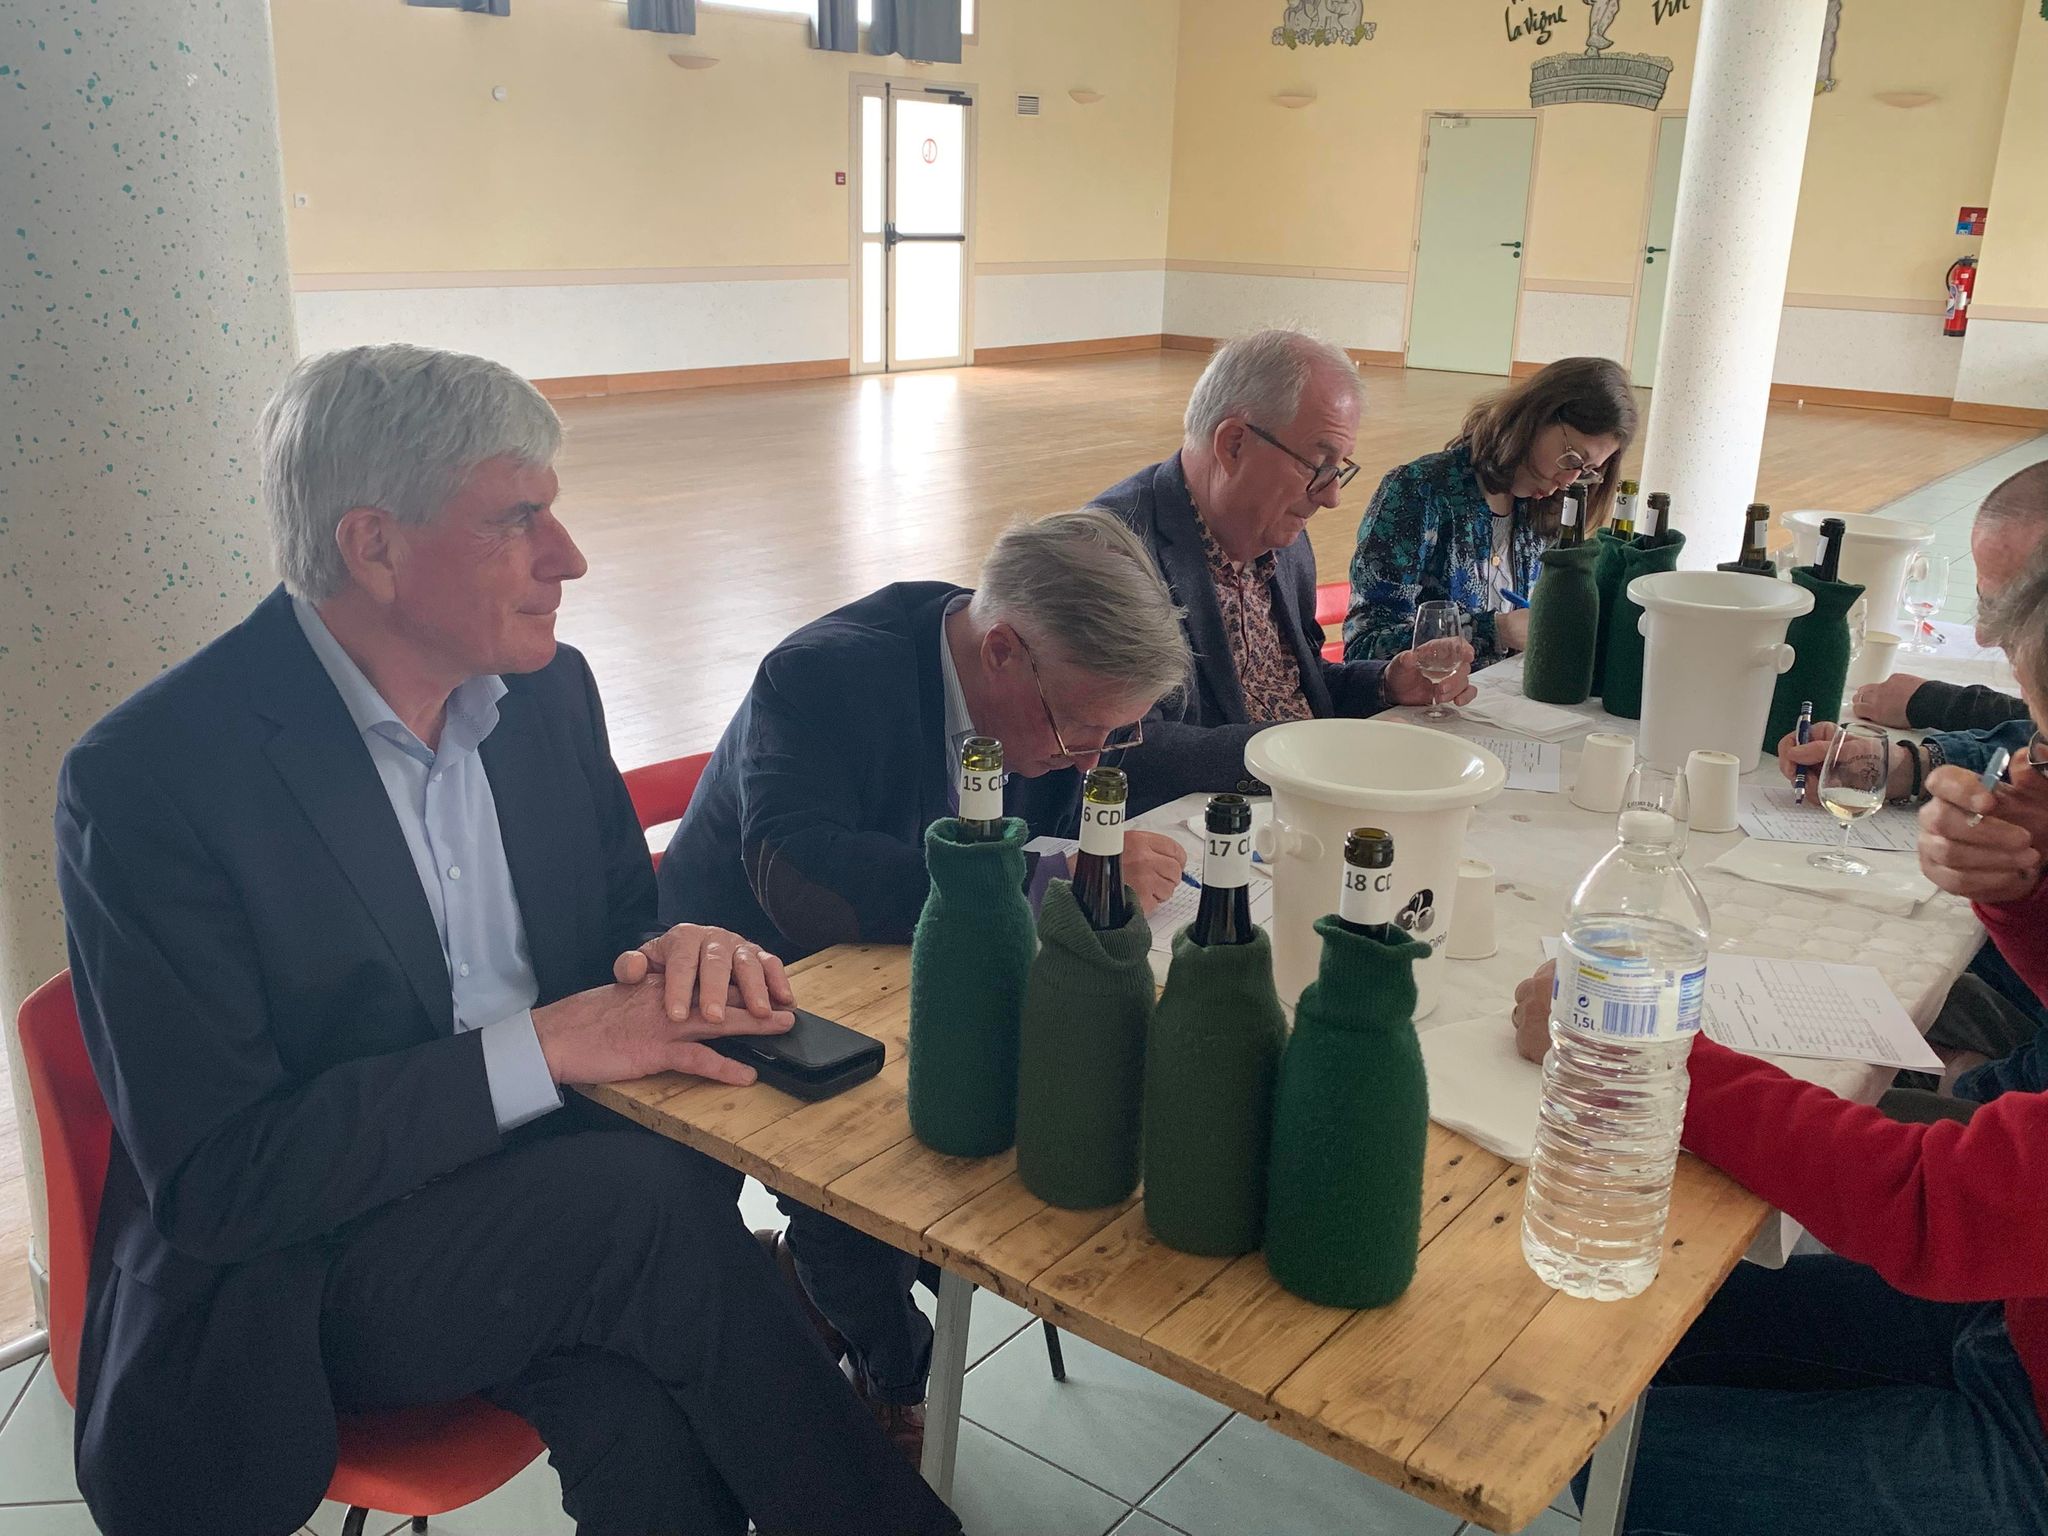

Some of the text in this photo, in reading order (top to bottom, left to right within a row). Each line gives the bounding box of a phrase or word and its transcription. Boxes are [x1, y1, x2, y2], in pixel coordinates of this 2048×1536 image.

[963, 775, 982, 792] 15
[1096, 807, 1124, 826] CD
[1209, 839, 1231, 857] 17
[1344, 870, 1367, 892] 18
